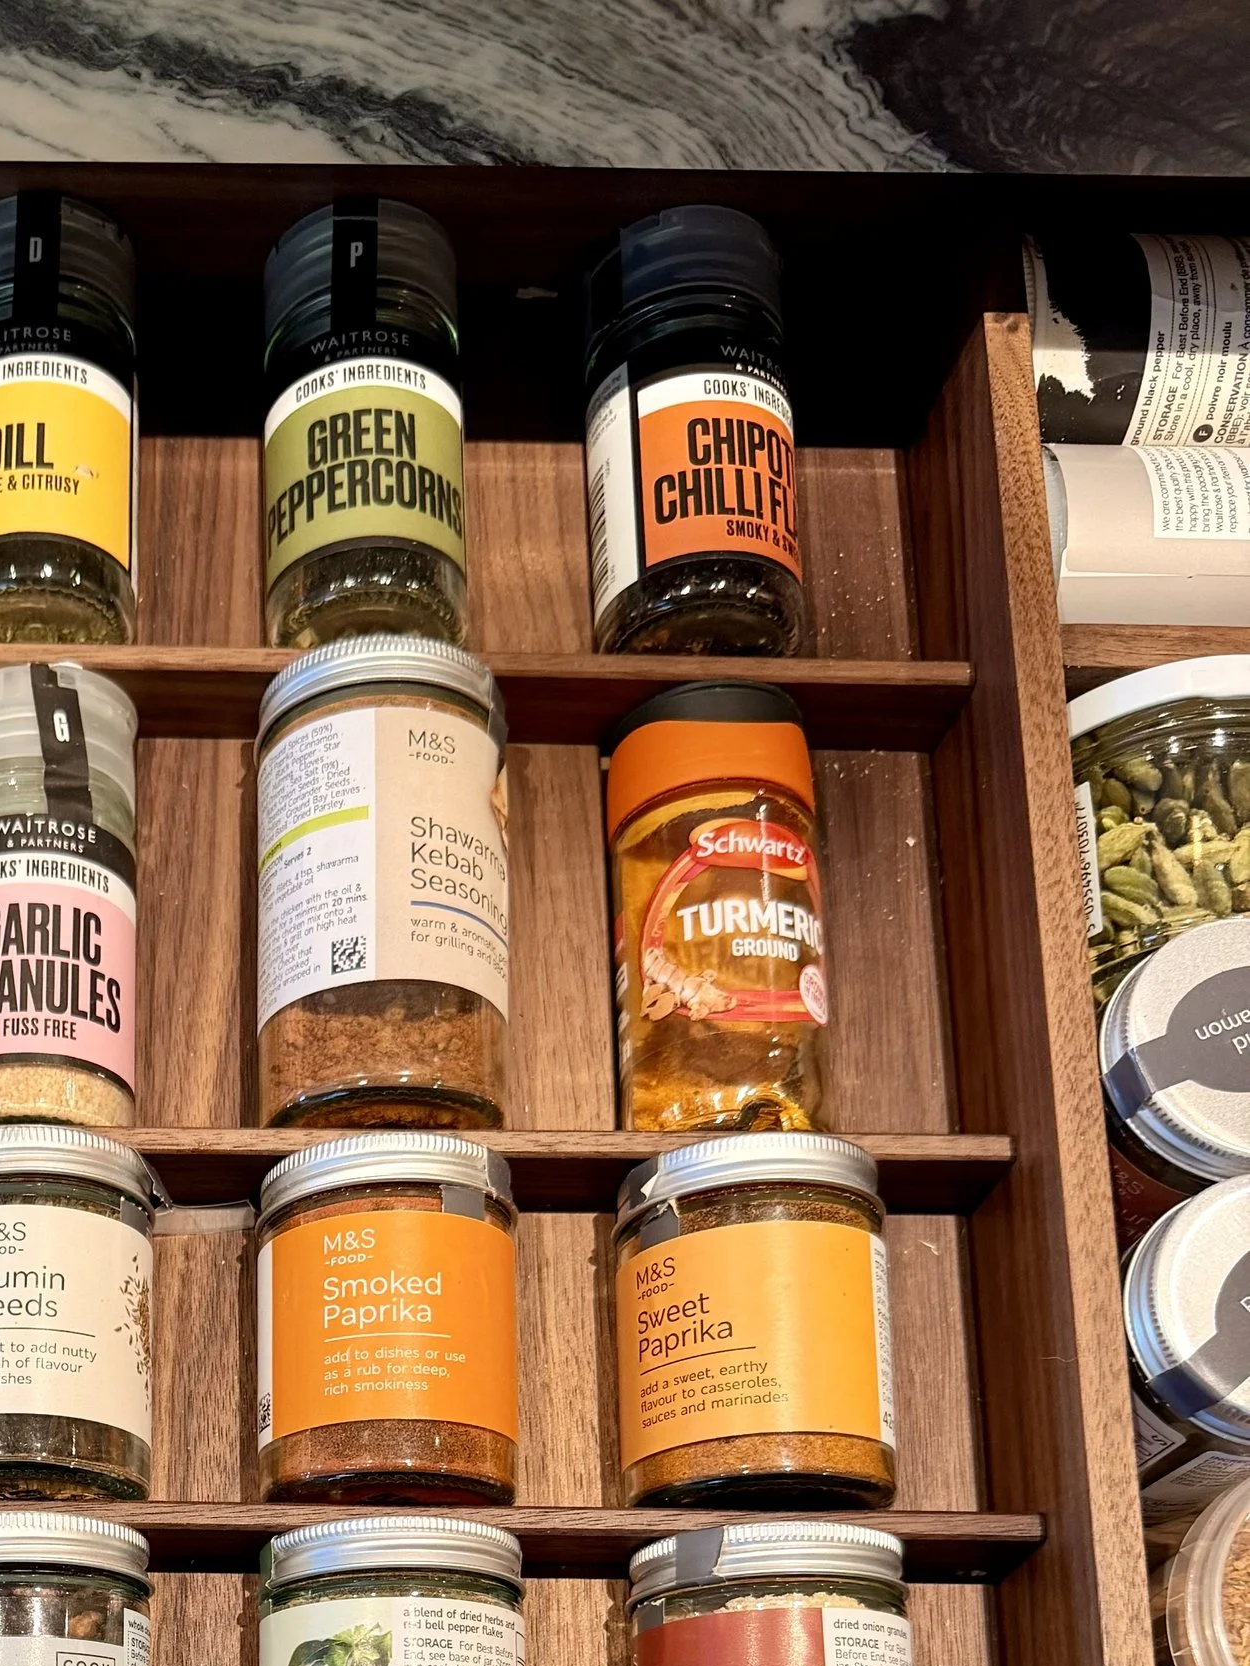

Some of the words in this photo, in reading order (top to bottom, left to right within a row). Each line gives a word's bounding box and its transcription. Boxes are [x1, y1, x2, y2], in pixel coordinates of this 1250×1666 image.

[2, 361, 88, 385] INGREDIENTS
[295, 368, 339, 403] COOKS'
[343, 363, 428, 391] INGREDIENTS
[1206, 386, 1222, 420] poivre
[1215, 360, 1227, 382] noir
[1221, 321, 1232, 356] moulu
[704, 379, 750, 397] COOKS'
[1131, 410, 1148, 446] ground
[1142, 376, 1158, 406] black
[1154, 331, 1165, 372] pepper
[1153, 386, 1177, 441] STORAGE
[307, 408, 417, 467] GREEN
[6, 475, 18, 492] &
[22, 473, 81, 496] CITRUSY
[654, 467, 763, 525] CHILLI
[267, 459, 463, 560] PEPPERCORNS
[726, 519, 769, 542] SMOKY
[773, 530, 780, 547] &
[53, 712, 70, 742] G
[408, 729, 456, 754] M&S
[7, 838, 15, 848] &
[20, 838, 84, 854] PARTNERS
[410, 815, 506, 882] Shawarma
[410, 843, 484, 881] Kebab
[696, 830, 807, 864] Schwartz
[26, 859, 109, 893] INGREDIENTS
[410, 868, 507, 936] Seasoning
[410, 917, 446, 930] warm
[450, 922, 458, 932] &
[677, 899, 823, 955] TURMERIC
[732, 938, 799, 962] GROUND
[3, 1017, 40, 1038] FUSS
[43, 1020, 77, 1040] FREE
[323, 1228, 375, 1255] M&S
[323, 1270, 442, 1301] Smoked
[636, 1257, 676, 1290] M&S
[323, 1298, 432, 1329] Paprika
[637, 1293, 709, 1335] Sweet
[639, 1320, 733, 1362] Paprika
[642, 1411, 677, 1429] sauces
[680, 1401, 706, 1416] and
[711, 1392, 788, 1409] marinades
[425, 1620, 445, 1630] bell
[448, 1622, 478, 1634] pepper
[482, 1624, 504, 1638] flakes
[833, 1619, 860, 1630] dried
[862, 1621, 885, 1632] onion
[834, 1636, 879, 1649] STORAGE
